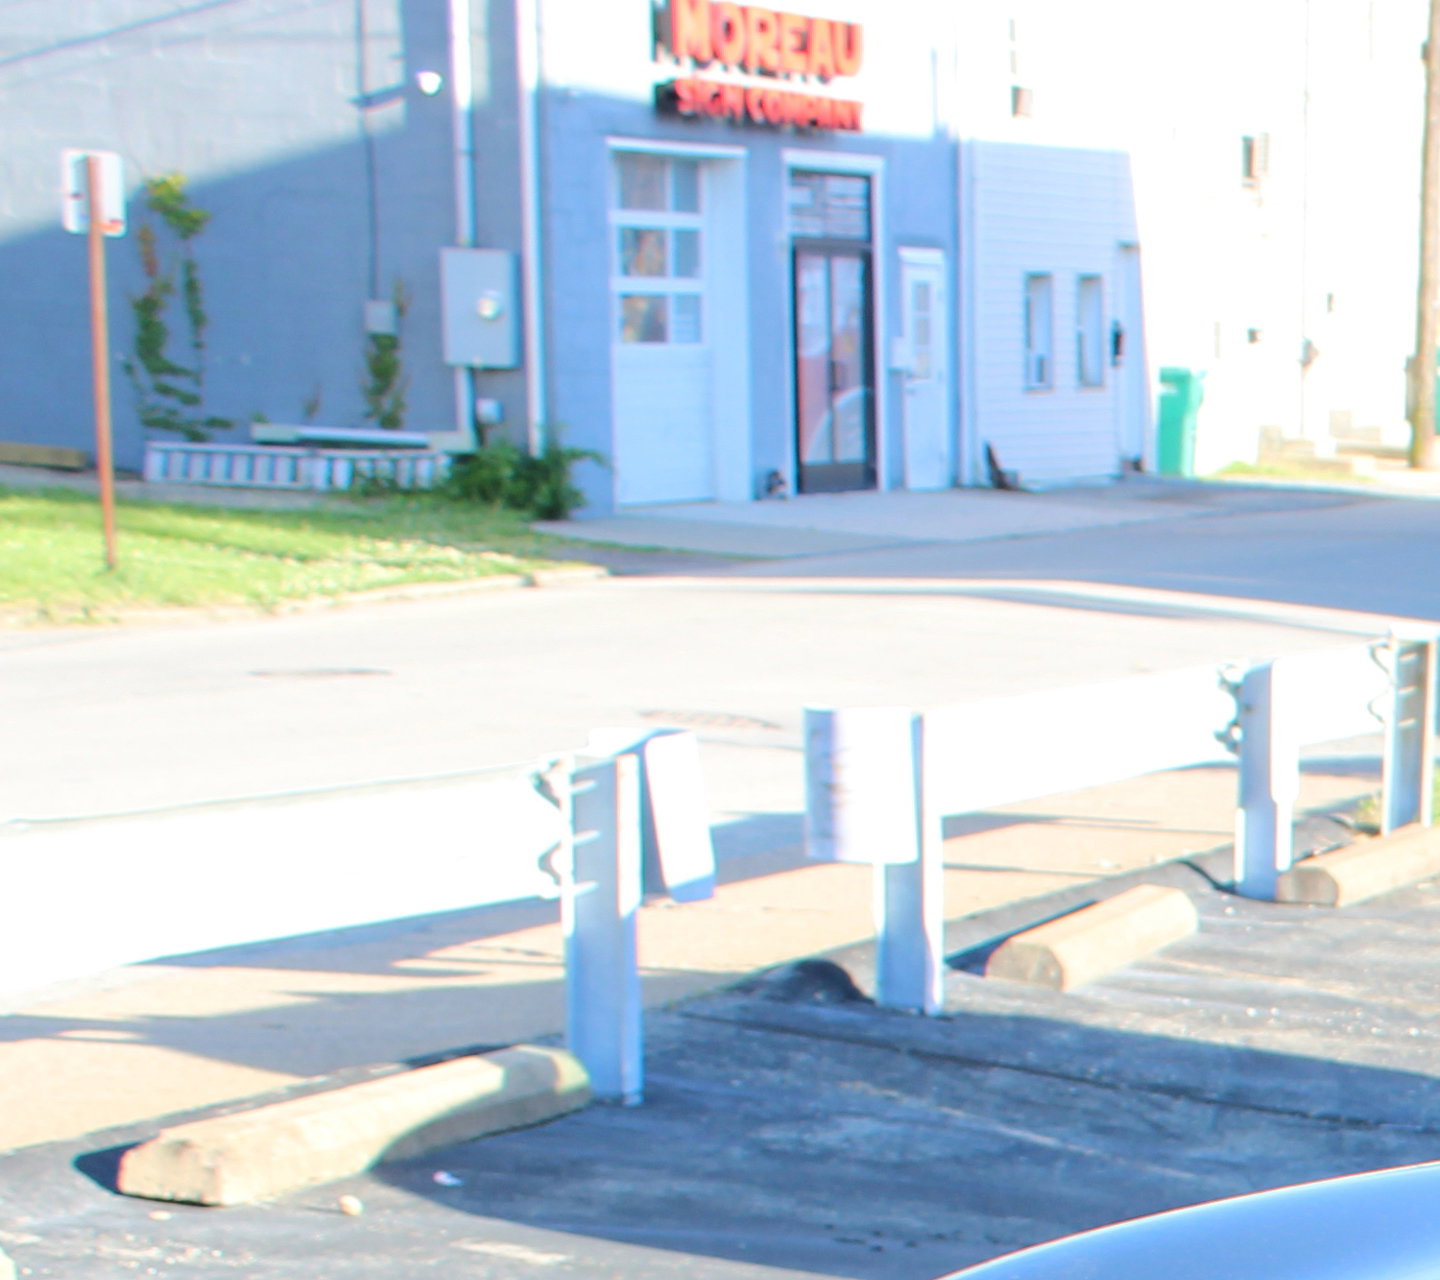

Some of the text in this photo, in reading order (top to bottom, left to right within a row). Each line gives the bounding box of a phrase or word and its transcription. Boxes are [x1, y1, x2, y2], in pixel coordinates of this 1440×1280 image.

[671, 0, 862, 76] MOREAU
[673, 77, 864, 132] SIGN COMPANY
